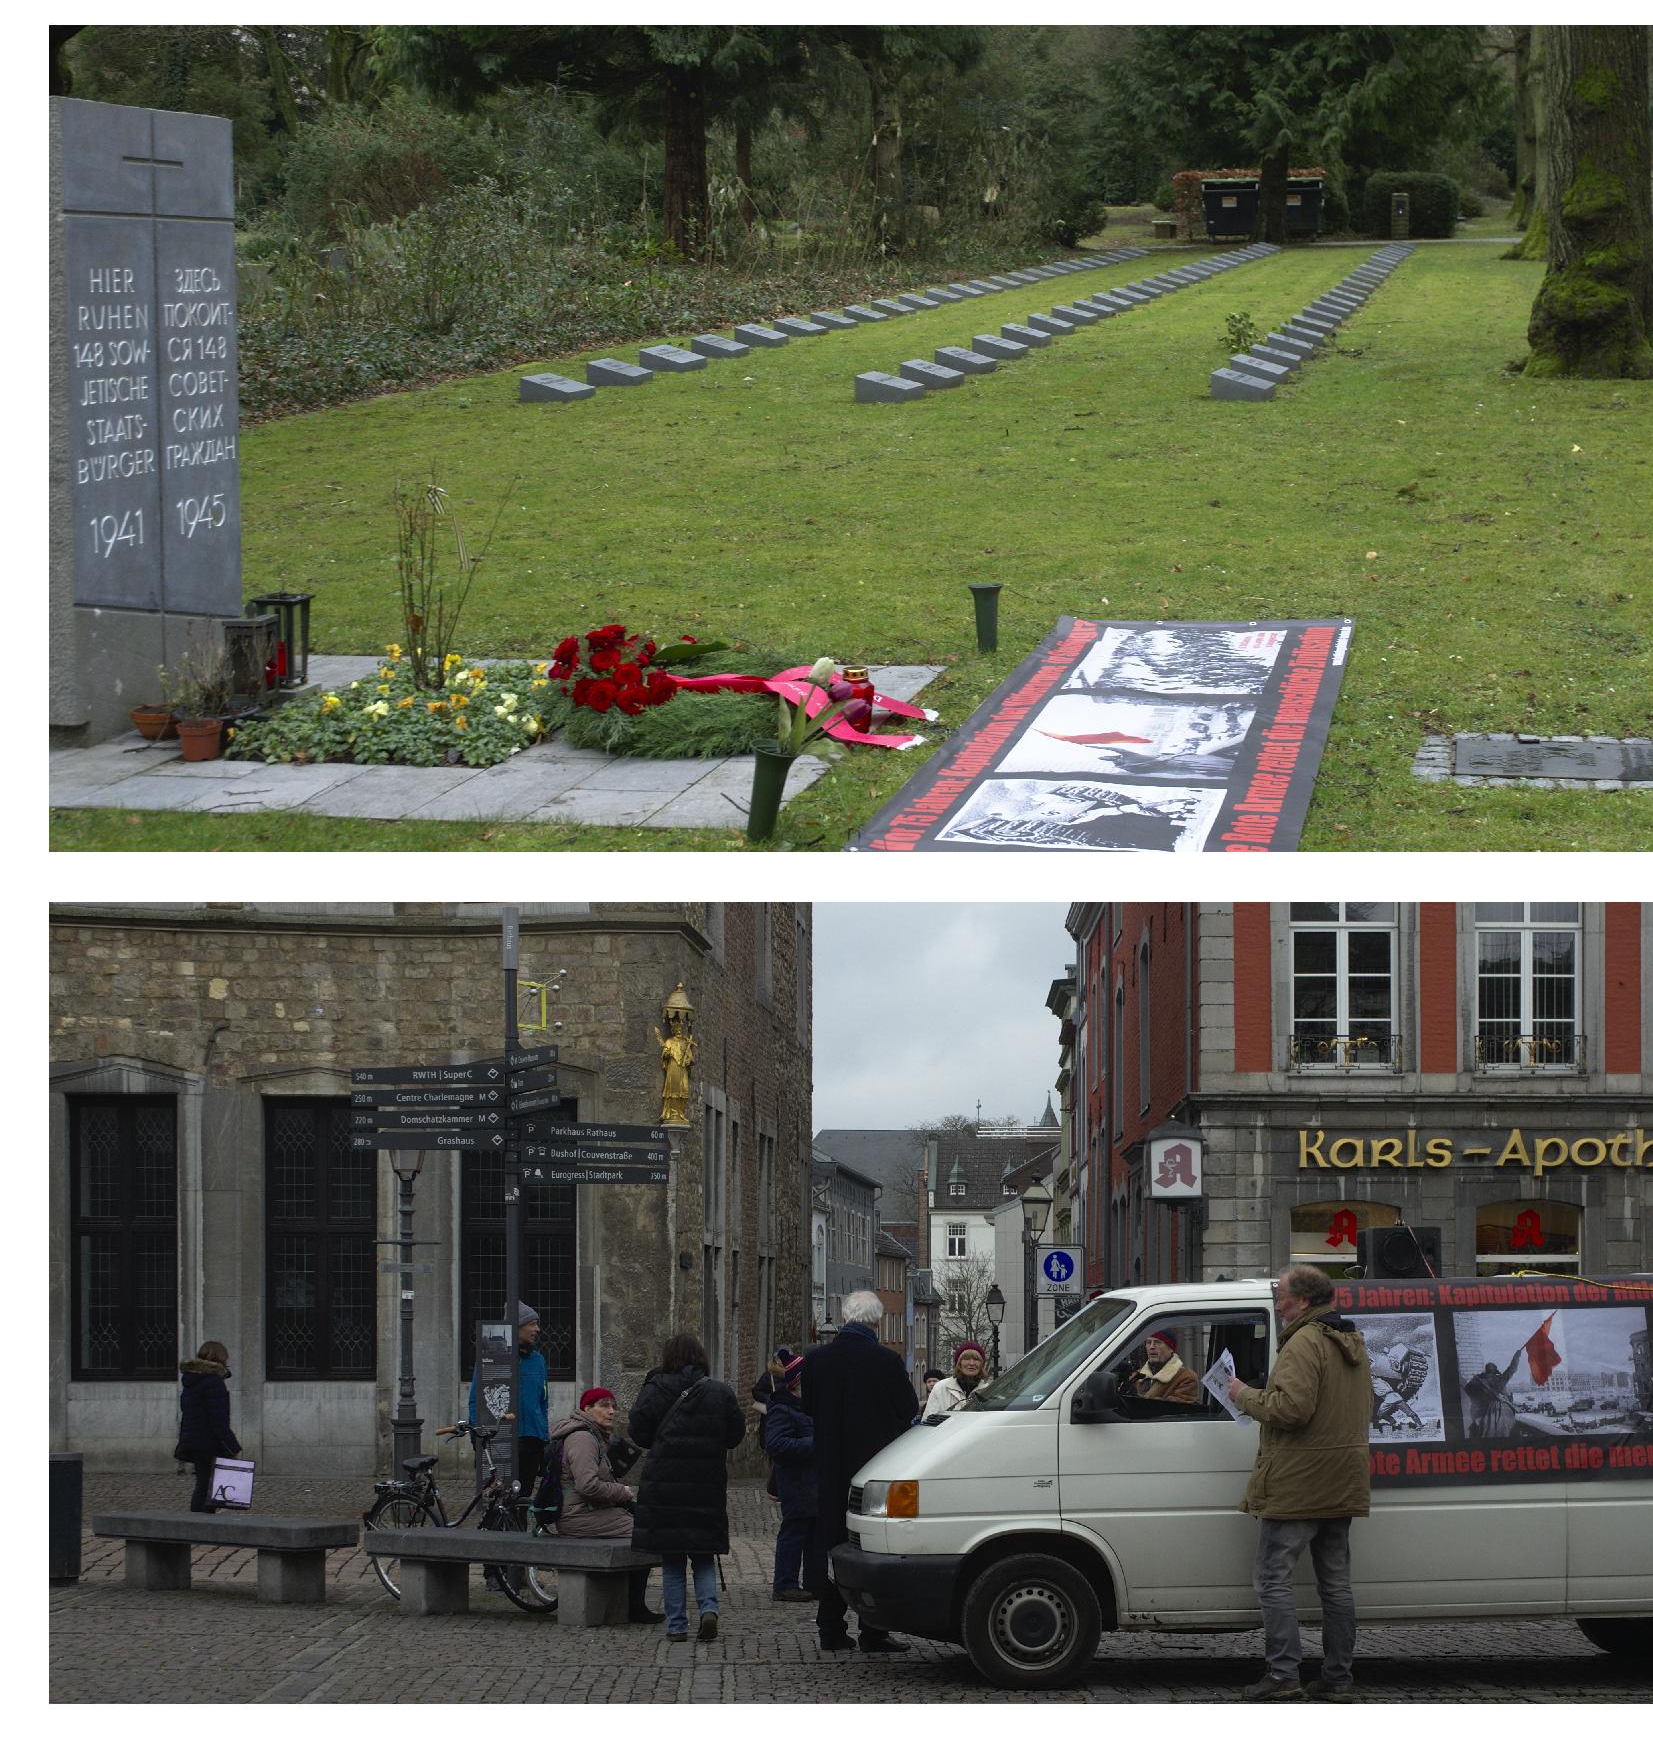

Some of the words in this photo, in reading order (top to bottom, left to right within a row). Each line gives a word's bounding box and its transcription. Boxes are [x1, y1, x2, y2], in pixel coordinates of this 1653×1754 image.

[89, 267, 136, 294] HIER
[173, 267, 222, 295] ЗДЕСЬ
[78, 304, 149, 332] RUHEN
[163, 302, 234, 329] ПОКОИТ-
[73, 341, 103, 369] 148
[109, 339, 151, 366] SOW-
[167, 336, 194, 363] СЯ
[197, 335, 227, 360] 148
[80, 374, 150, 407] JETISCHE
[168, 370, 230, 397] СОВЕТ-
[86, 413, 149, 446] STAATS-
[173, 404, 225, 433] СКИХ
[166, 435, 237, 470] ГРАЖДАН
[78, 449, 156, 485] BÜRGER
[176, 492, 226, 539] 1945
[89, 507, 145, 559] 1941
[412, 1070, 438, 1080] RWTH
[396, 1092, 423, 1102] Centre
[423, 1092, 474, 1104] Charlemagne
[400, 1113, 475, 1125] Domschatzkammer
[550, 1126, 585, 1137] Parkhaus
[585, 1128, 617, 1138] Rathaus
[437, 1135, 476, 1146] Grashaus
[1045, 1282, 1072, 1293] ZONE
[1358, 1285, 1435, 1308] Jahren:
[1439, 1282, 1570, 1307] Kapitulation
[1573, 1281, 1609, 1303] der
[1405, 1447, 1488, 1476] Armee
[1491, 1444, 1562, 1473] rettet
[1564, 1442, 1605, 1468] die
